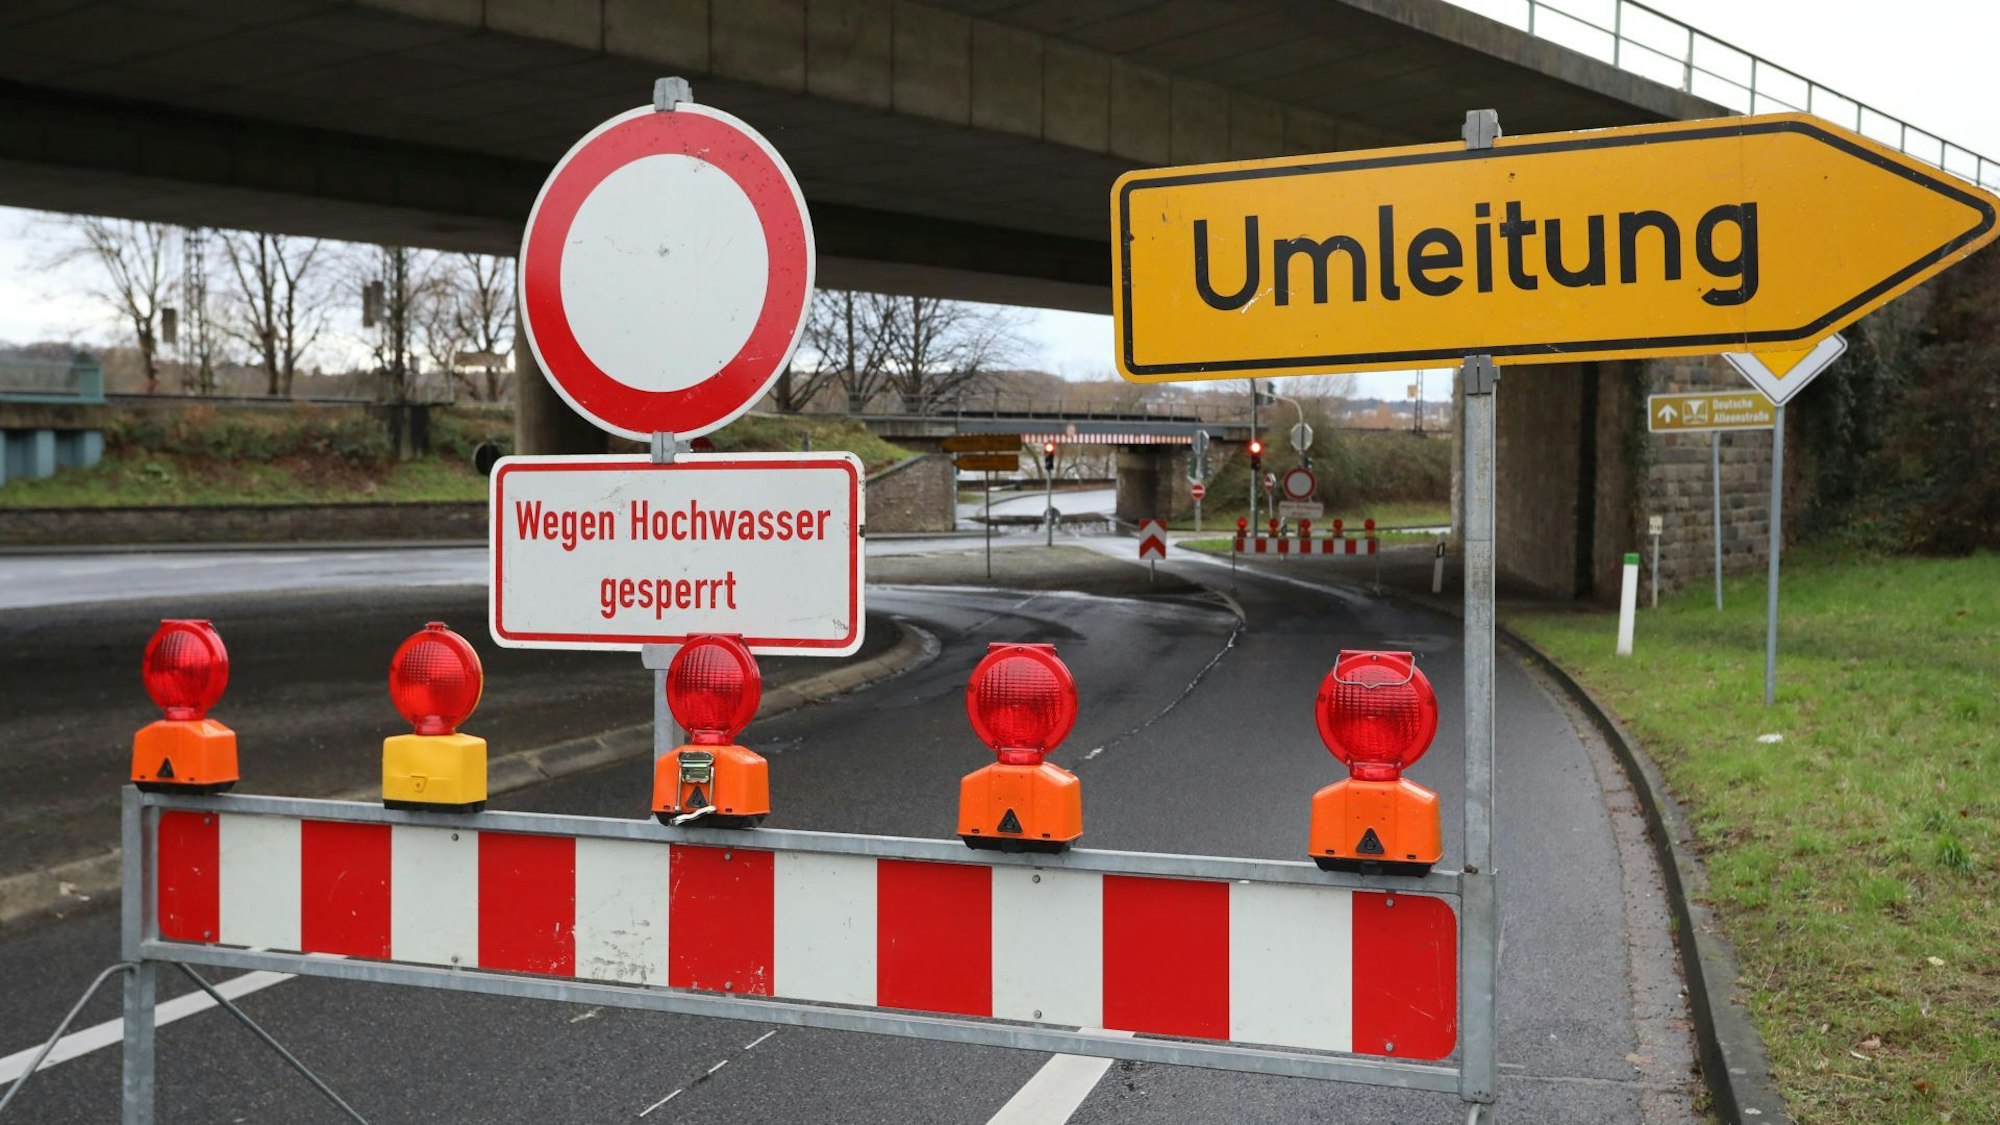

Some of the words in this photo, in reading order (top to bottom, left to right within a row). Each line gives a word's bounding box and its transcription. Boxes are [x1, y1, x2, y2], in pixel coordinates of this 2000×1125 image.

[1193, 202, 1759, 310] Umleitung
[1712, 398, 1753, 409] Deutsche
[515, 500, 615, 552] Wegen
[630, 500, 831, 541] Hochwasser
[600, 571, 737, 620] gesperrt
